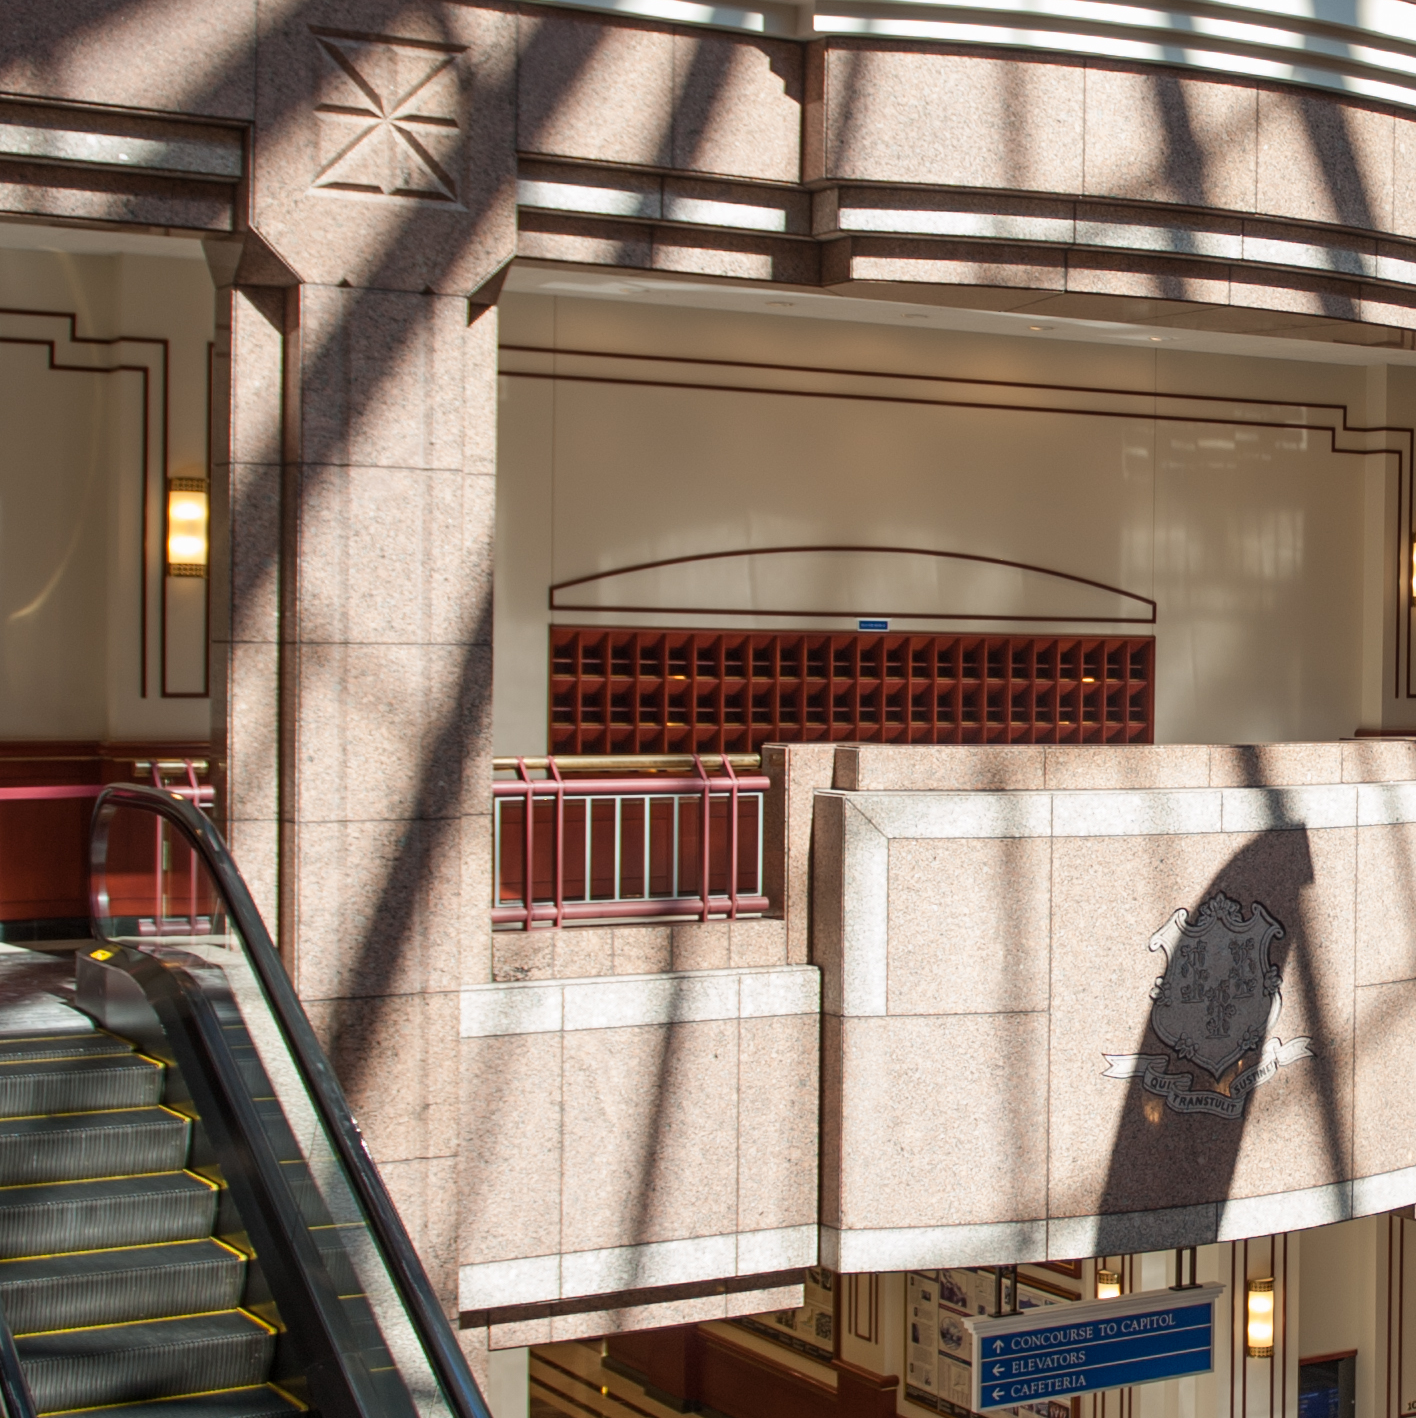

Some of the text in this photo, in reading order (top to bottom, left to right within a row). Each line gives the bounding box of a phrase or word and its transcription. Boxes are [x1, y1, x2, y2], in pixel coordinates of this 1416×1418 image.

[1150, 1076, 1171, 1091] QUI
[1233, 1059, 1275, 1096] SUSTINET
[1172, 1093, 1237, 1113] TRANSTULIT
[1010, 1312, 1177, 1350] CONCOURSE TO CAPITOL
[1011, 1350, 1087, 1375] ELEVATORS
[1010, 1374, 1087, 1399] CAFETERIA
